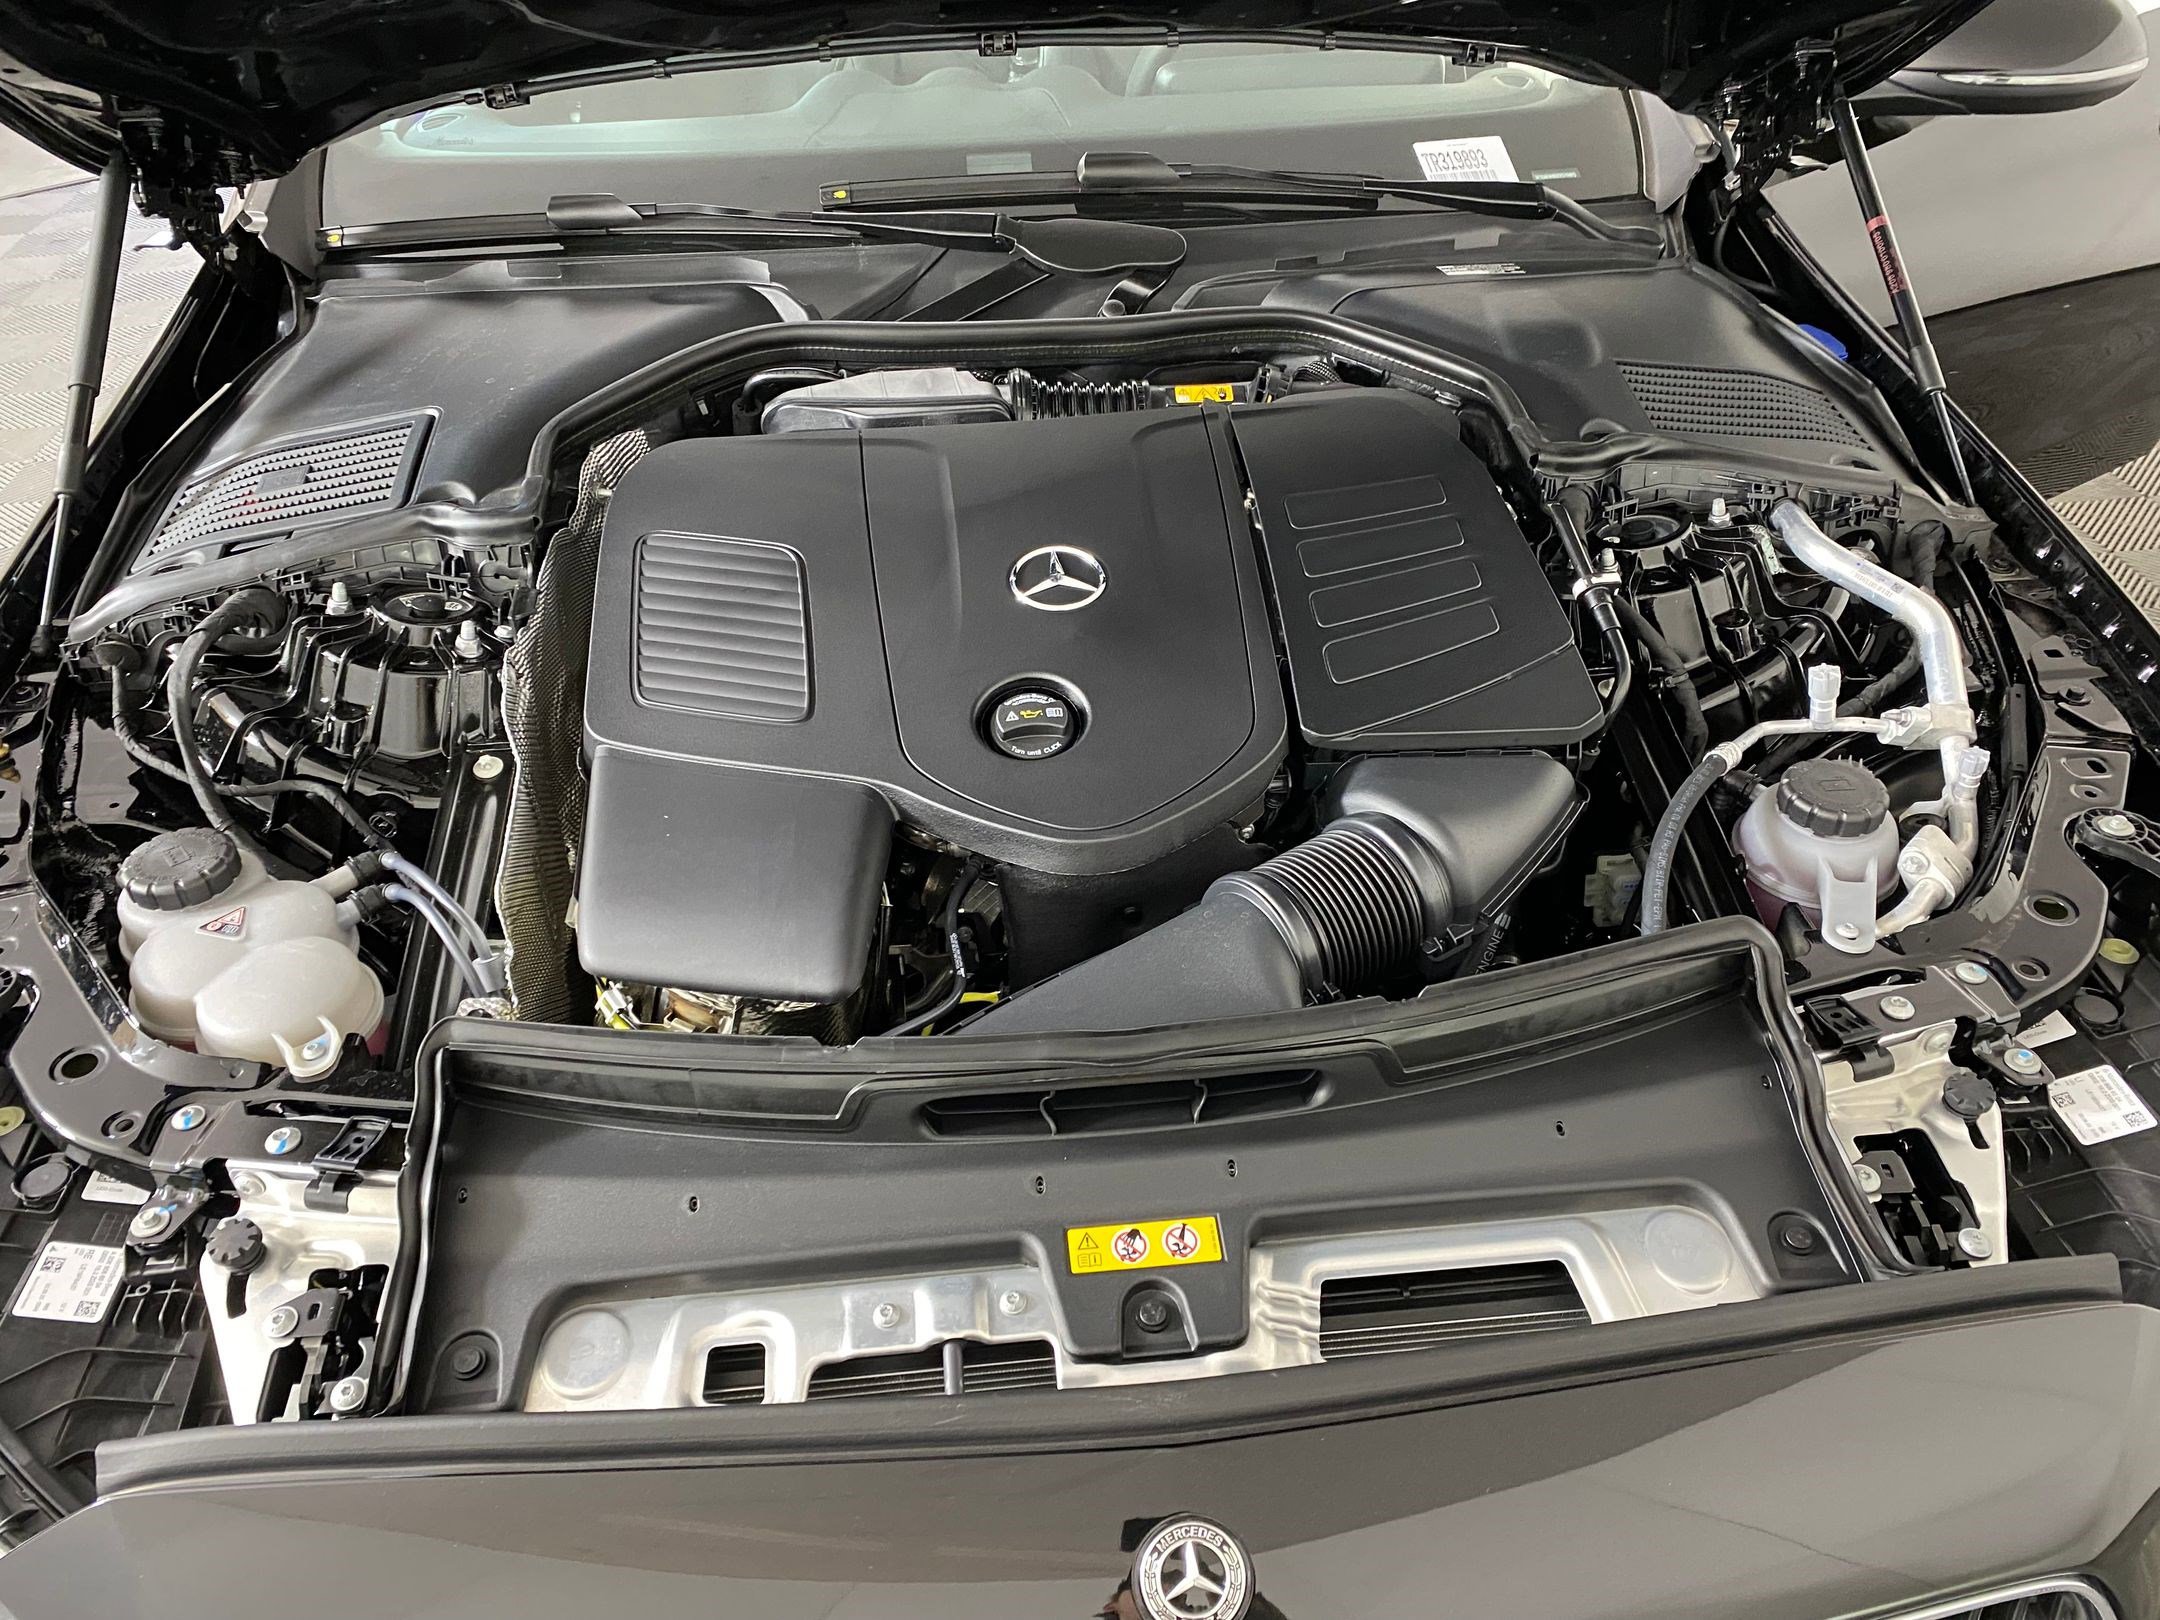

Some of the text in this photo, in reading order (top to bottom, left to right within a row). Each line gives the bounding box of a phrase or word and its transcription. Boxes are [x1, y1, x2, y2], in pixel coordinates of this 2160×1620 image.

[1421, 148, 1489, 173] TR319893
[1011, 745, 1025, 755] Turn
[1043, 741, 1062, 754] CLICK
[1474, 928, 1505, 975] NGINE
[1155, 1526, 1224, 1553] MERCEDES
